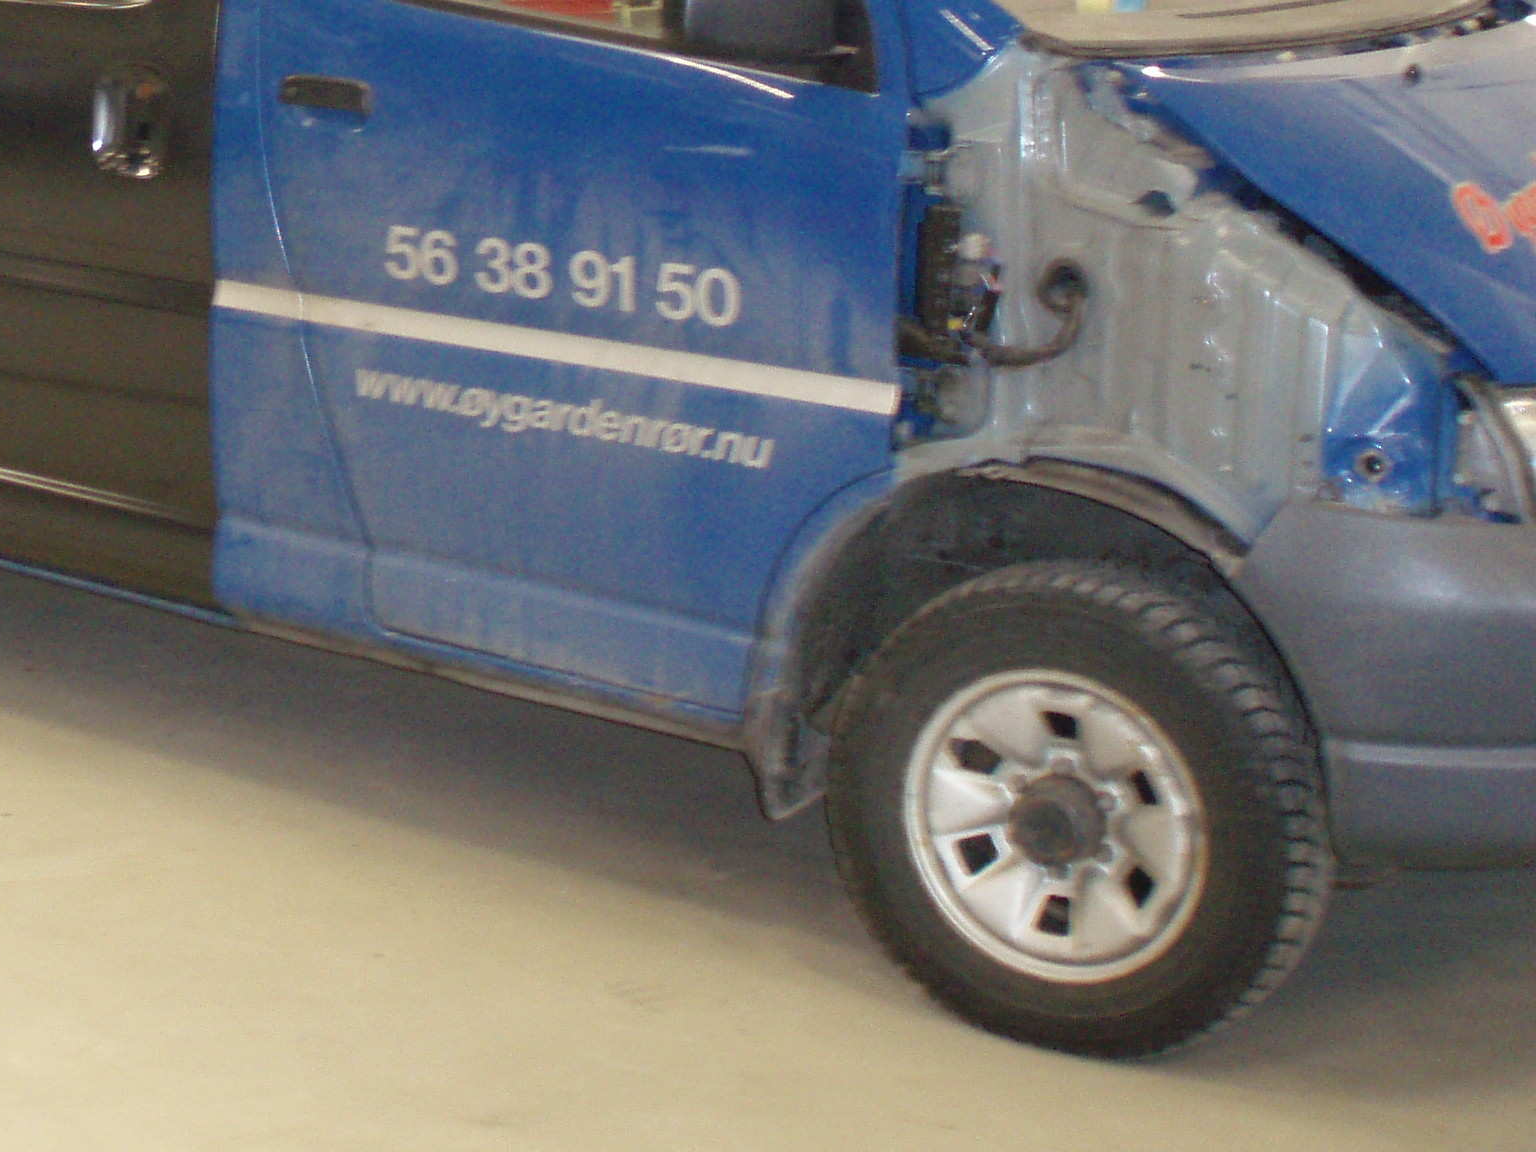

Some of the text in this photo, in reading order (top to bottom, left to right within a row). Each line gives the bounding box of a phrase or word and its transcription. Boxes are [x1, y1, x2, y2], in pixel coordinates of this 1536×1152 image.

[384, 225, 741, 327] 56 38 91 50
[355, 368, 775, 469] www.øygardenrør.nu
